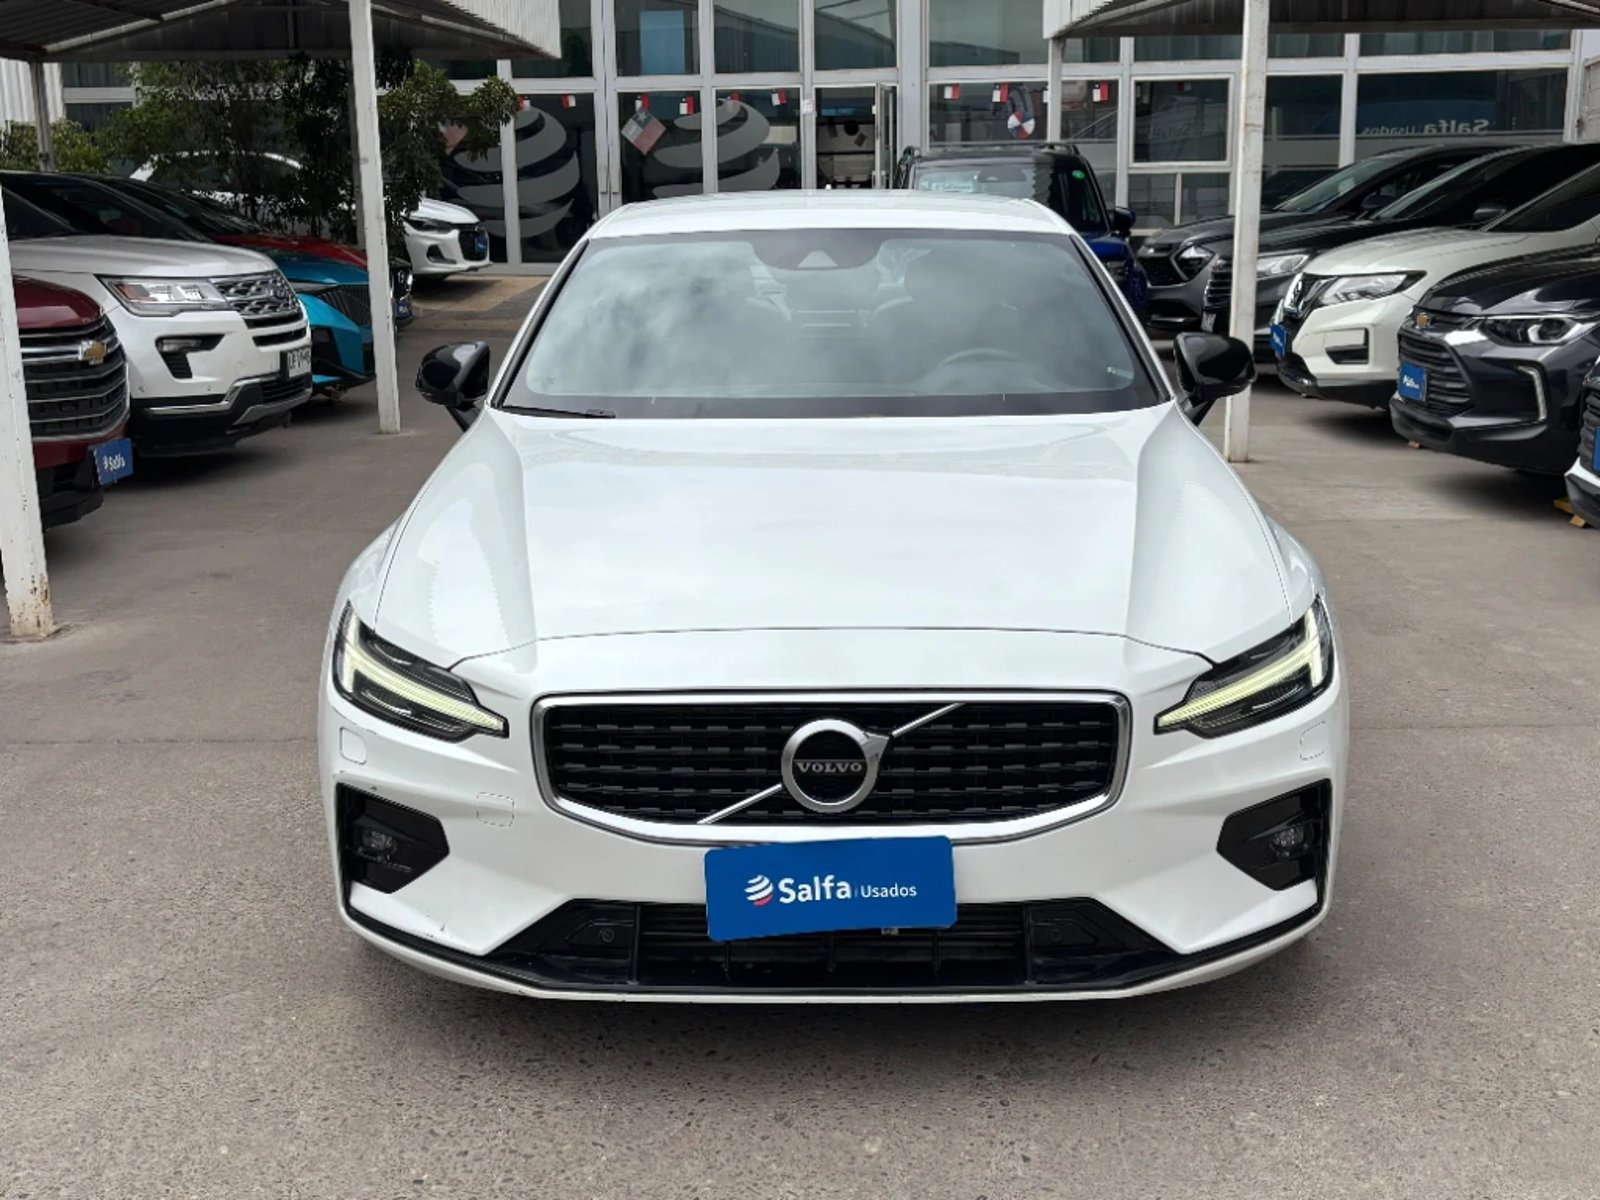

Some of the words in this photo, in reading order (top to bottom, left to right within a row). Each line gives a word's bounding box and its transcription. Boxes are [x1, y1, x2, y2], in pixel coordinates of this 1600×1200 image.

[796, 762, 863, 773] VOLVO
[778, 875, 851, 904] Salfa
[860, 883, 917, 898] Usados
